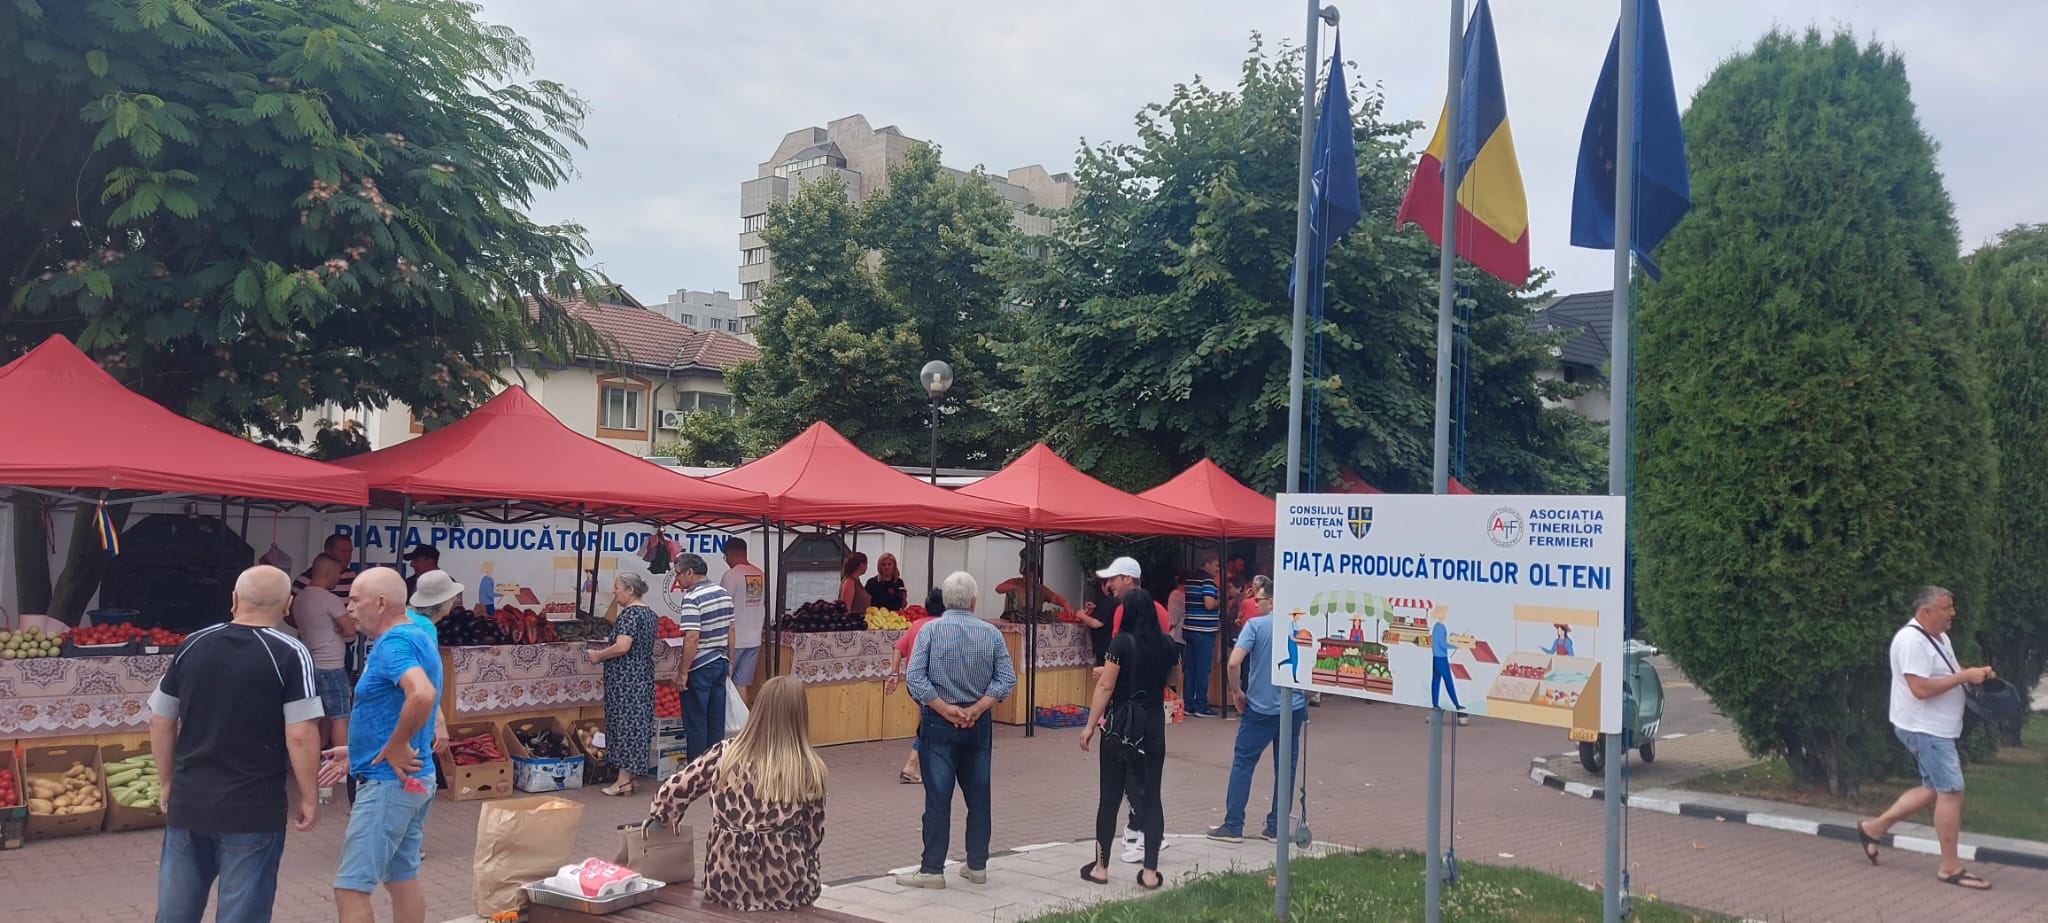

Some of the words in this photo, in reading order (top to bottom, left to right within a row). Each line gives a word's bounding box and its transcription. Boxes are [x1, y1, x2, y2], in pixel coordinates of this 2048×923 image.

[1290, 506, 1344, 516] CONSILIUL
[1323, 529, 1344, 539] OLT
[1529, 523, 1603, 535] TINERILOR
[1529, 536, 1594, 548] FERMIERI
[1339, 553, 1519, 585] PRODUCĂTORILOR
[1529, 563, 1612, 591] OLTENI
